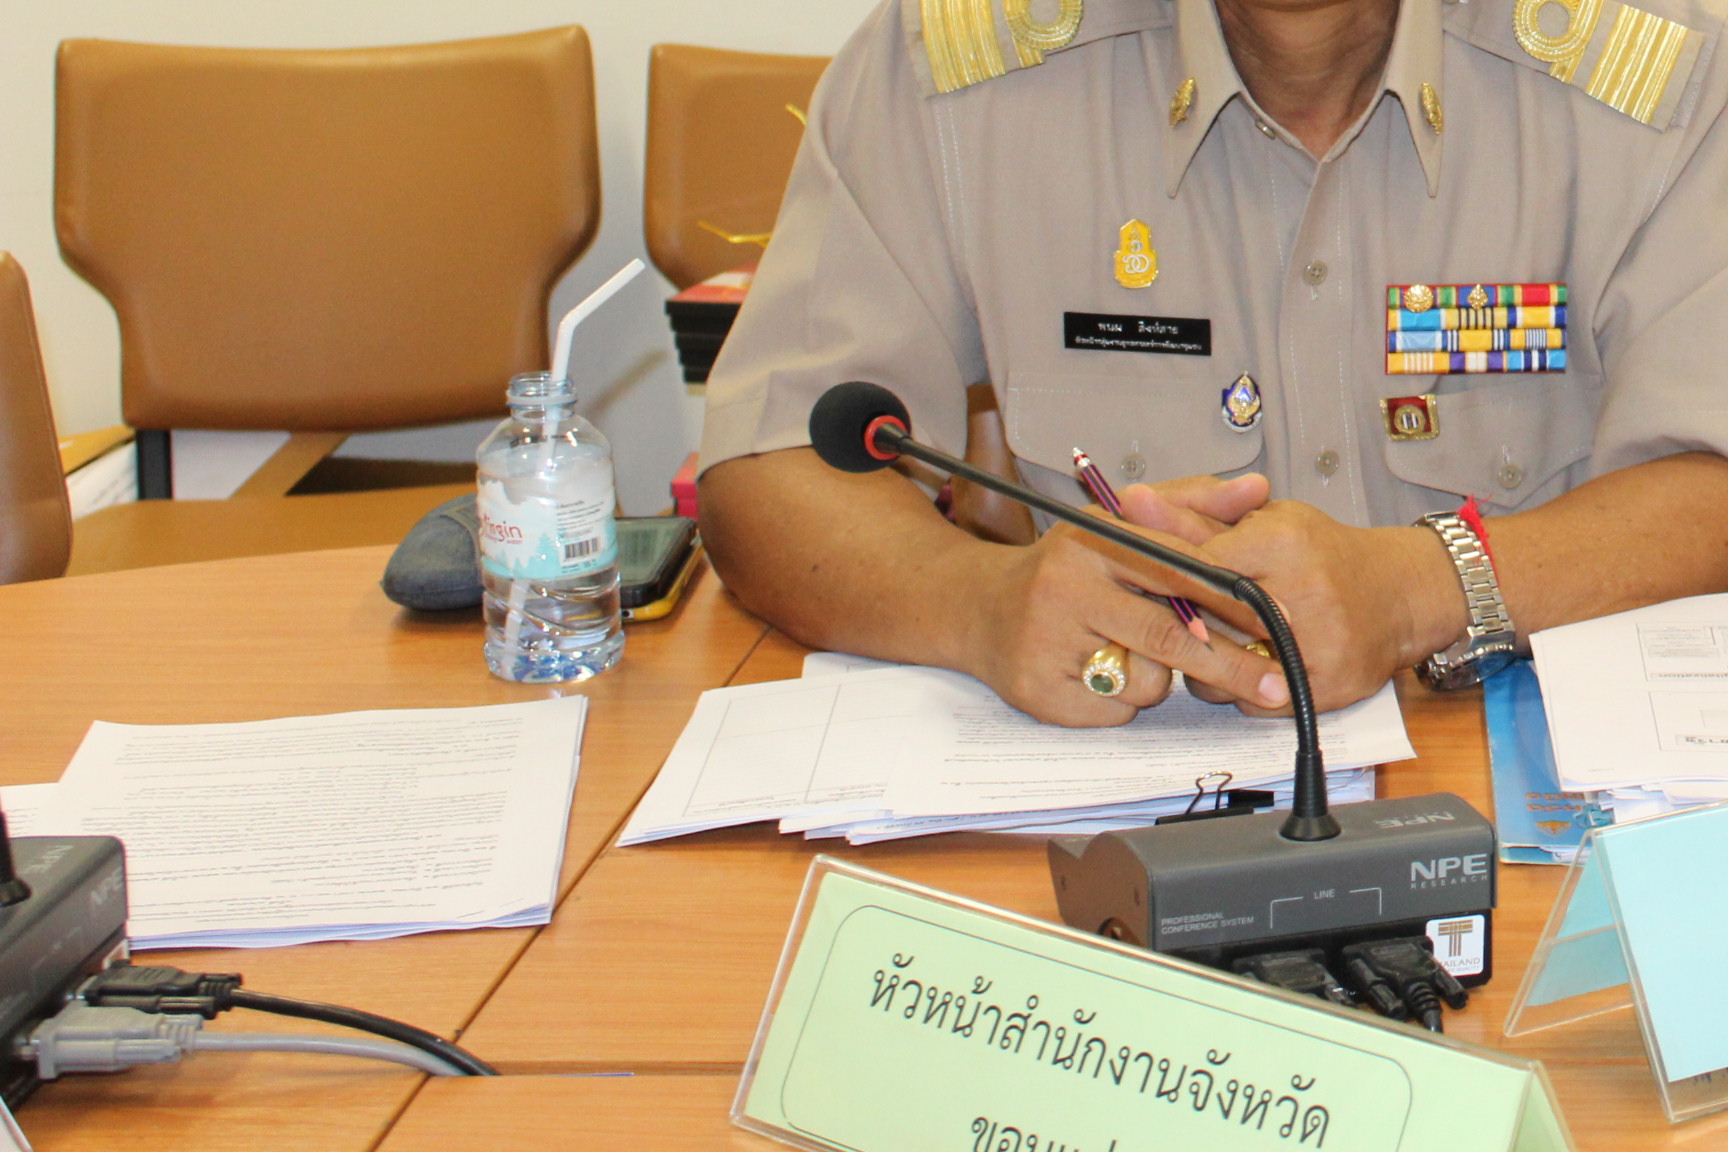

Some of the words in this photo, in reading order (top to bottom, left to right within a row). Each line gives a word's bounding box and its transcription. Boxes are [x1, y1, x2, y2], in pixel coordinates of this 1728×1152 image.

[1410, 852, 1489, 883] NPE
[1410, 873, 1489, 891] RESEARCH
[1314, 889, 1335, 899] LINE
[1161, 912, 1224, 926] PROFESSIONAL
[1161, 921, 1218, 935] CONFERENCE
[1221, 917, 1254, 927] SYSTEM
[867, 952, 1333, 1152] หัวหน้าสำนักงานจังหวัด
